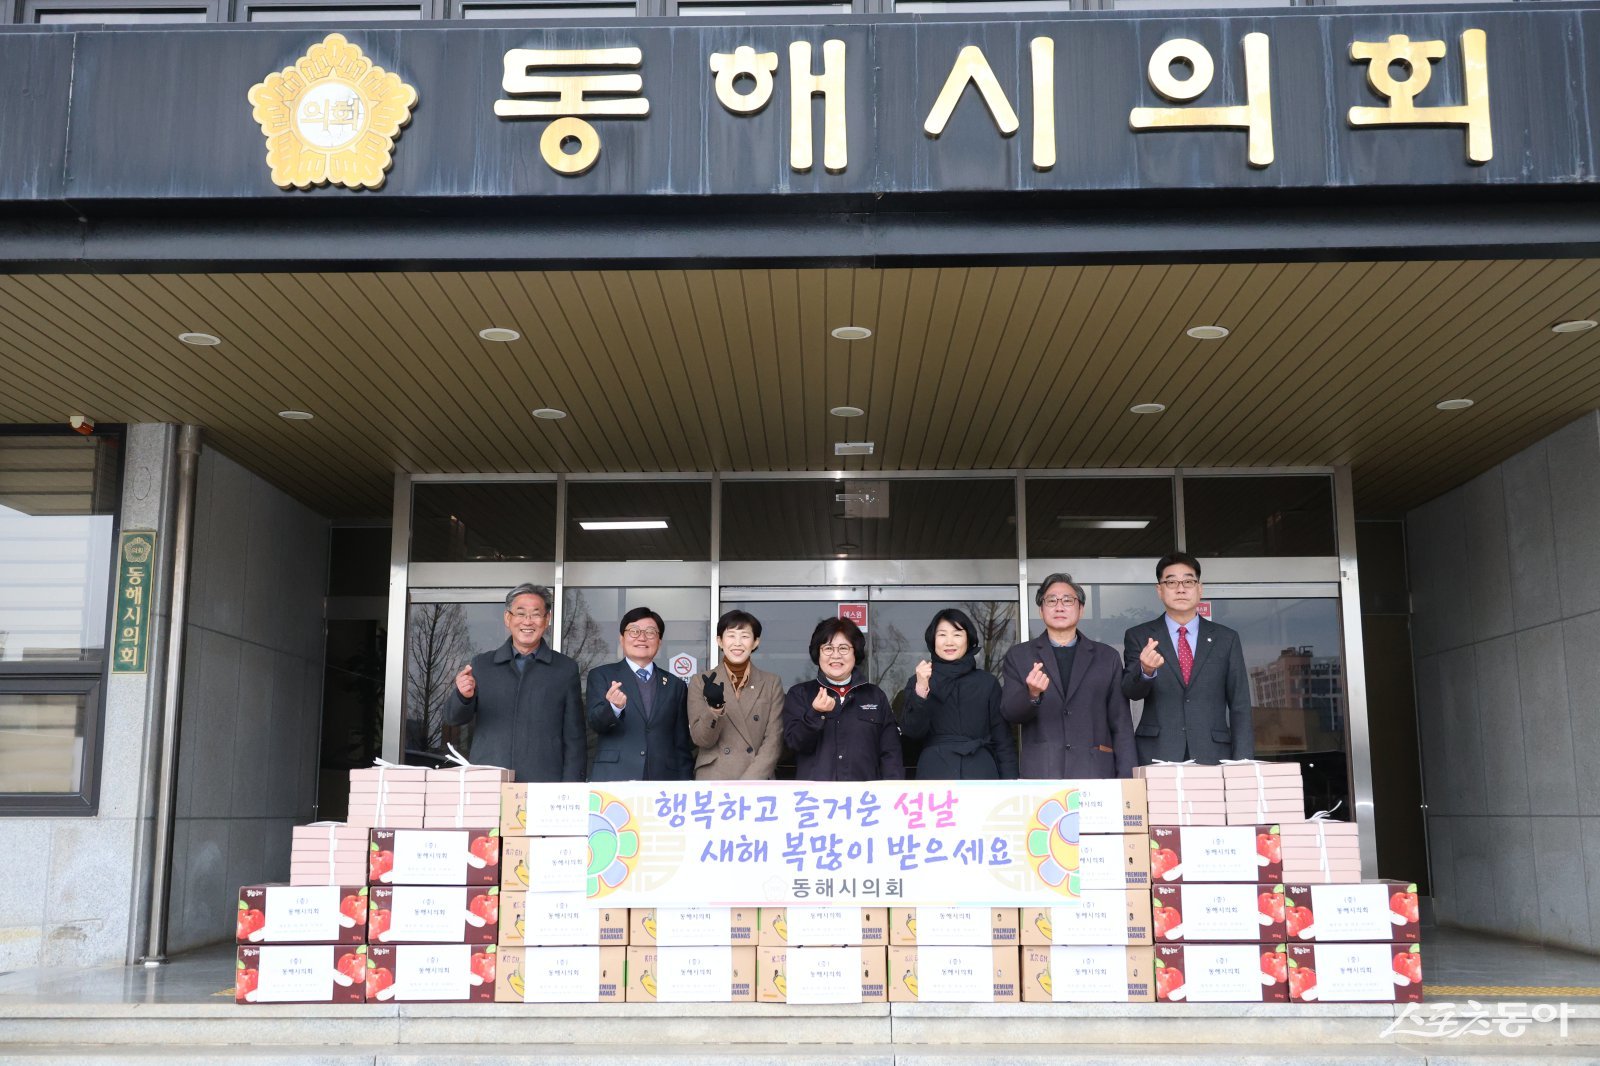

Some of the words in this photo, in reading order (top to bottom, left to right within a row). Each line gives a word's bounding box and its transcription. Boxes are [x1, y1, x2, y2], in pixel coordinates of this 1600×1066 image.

[300, 97, 360, 132] 의회
[493, 28, 1494, 178] 동해시의회
[120, 566, 145, 666] 동해시의회
[843, 610, 862, 618] 에스원
[656, 792, 778, 829] 행복하고
[795, 791, 881, 829] 즐거운
[894, 790, 959, 829] 설날
[700, 835, 768, 863] 새해
[783, 832, 873, 872] 복많이
[887, 834, 1012, 871] 받으세요
[792, 877, 904, 898] 동해시의회
